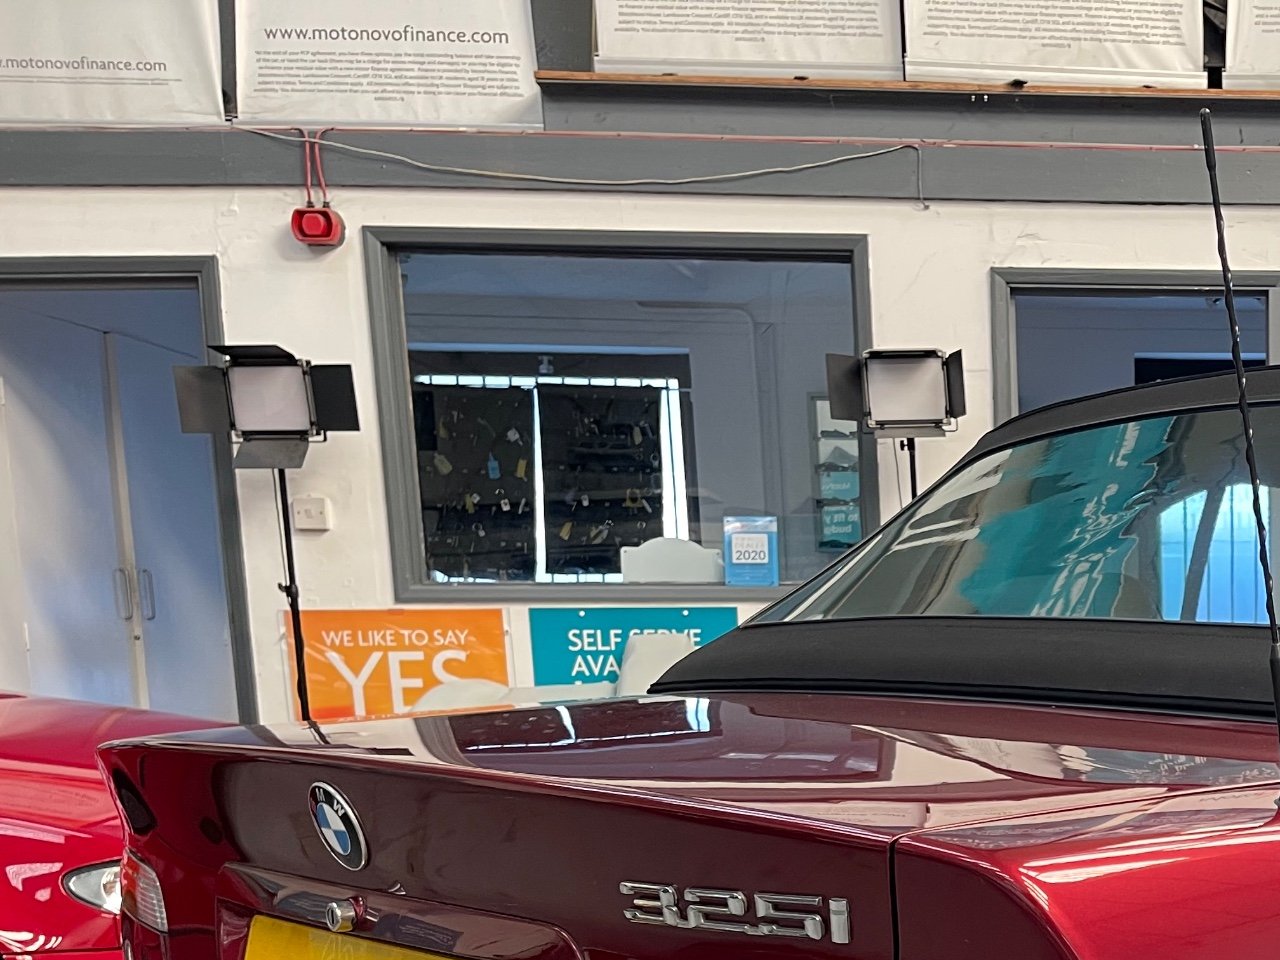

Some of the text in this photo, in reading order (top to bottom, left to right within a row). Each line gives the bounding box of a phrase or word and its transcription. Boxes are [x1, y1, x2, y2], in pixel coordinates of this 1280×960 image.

[264, 24, 509, 45] www.motonovofinance.com
[735, 550, 766, 561] 2020
[321, 629, 468, 648] WE LIKE TO SAY
[567, 629, 623, 652] SELF
